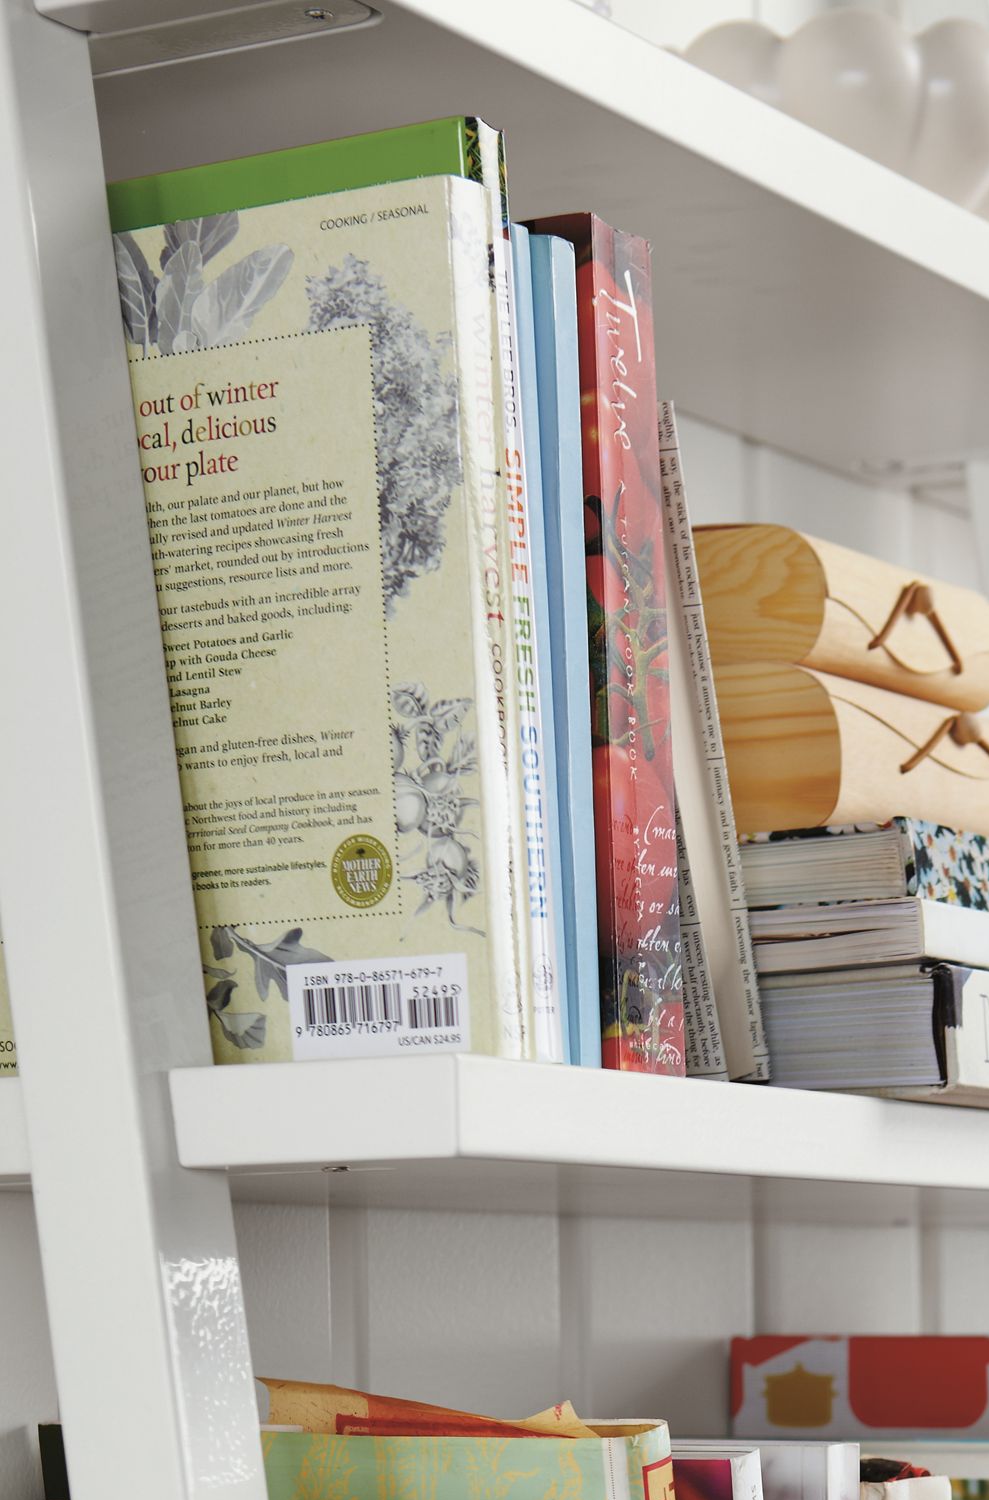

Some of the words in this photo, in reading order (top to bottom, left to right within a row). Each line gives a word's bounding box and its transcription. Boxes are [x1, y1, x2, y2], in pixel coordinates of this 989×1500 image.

[319, 211, 368, 232] COOKING
[377, 203, 429, 222] SEASONAL
[592, 270, 642, 449] Twelve
[139, 394, 174, 417] out
[180, 383, 206, 411] of
[208, 380, 279, 406] winter
[138, 422, 177, 452] cal,
[182, 415, 277, 444] delicious
[142, 462, 181, 483] our
[186, 451, 239, 486] plate
[168, 501, 185, 510] our
[188, 496, 219, 510] palate
[221, 491, 240, 503] and
[243, 491, 261, 500] our
[302, 482, 319, 493] but
[322, 480, 344, 489] how
[171, 516, 187, 525] the
[191, 513, 207, 523] last
[211, 508, 256, 521] tomatoes
[260, 506, 276, 515] are
[279, 501, 304, 512] done
[307, 496, 327, 508] and
[330, 495, 347, 505] the
[505, 448, 529, 584] SIMPLE
[171, 528, 207, 542] revised
[210, 525, 229, 536] and
[232, 520, 273, 536] updated
[277, 516, 310, 528] Winter
[313, 511, 352, 524] Harvest
[215, 541, 252, 552] recipes
[254, 531, 314, 548] showcasing
[317, 527, 344, 540] fresh
[175, 561, 213, 574] market,
[216, 554, 259, 568] rounded
[262, 554, 278, 562] out
[281, 550, 293, 562] by
[297, 543, 369, 559] introductions
[165, 576, 226, 592] suggestions,
[229, 570, 272, 583] resource
[276, 567, 297, 578] lists
[300, 563, 319, 575] and
[181, 599, 229, 614] tastebuds
[232, 595, 256, 606] with
[258, 595, 271, 605] an
[275, 587, 329, 602] incredible
[332, 585, 361, 596] array
[161, 620, 202, 632] desserts
[205, 615, 225, 627] and
[227, 611, 258, 625] baked
[261, 608, 294, 623] goods,
[297, 602, 352, 616] including:
[194, 637, 236, 649] Potatoes
[240, 633, 259, 644] and
[262, 629, 293, 642] Garlic
[180, 655, 202, 665] with
[205, 651, 238, 663] Gouda
[241, 648, 276, 659] Cheese
[513, 597, 536, 713] FRESH
[186, 668, 216, 680] Lentil
[219, 667, 242, 677] Stew
[200, 698, 232, 710] Barley
[202, 714, 227, 725] Cake
[200, 741, 219, 753] and
[222, 737, 278, 753] gluten-free
[321, 730, 354, 740] Winter
[186, 760, 215, 771] wants
[218, 758, 228, 767] to
[231, 755, 258, 767] enjoy
[294, 747, 320, 760] local
[323, 745, 343, 757] and
[304, 975, 328, 986] ISBN
[295, 1026, 303, 1039] 9
[310, 1024, 351, 1037] 780865
[357, 1021, 400, 1035] 716797
